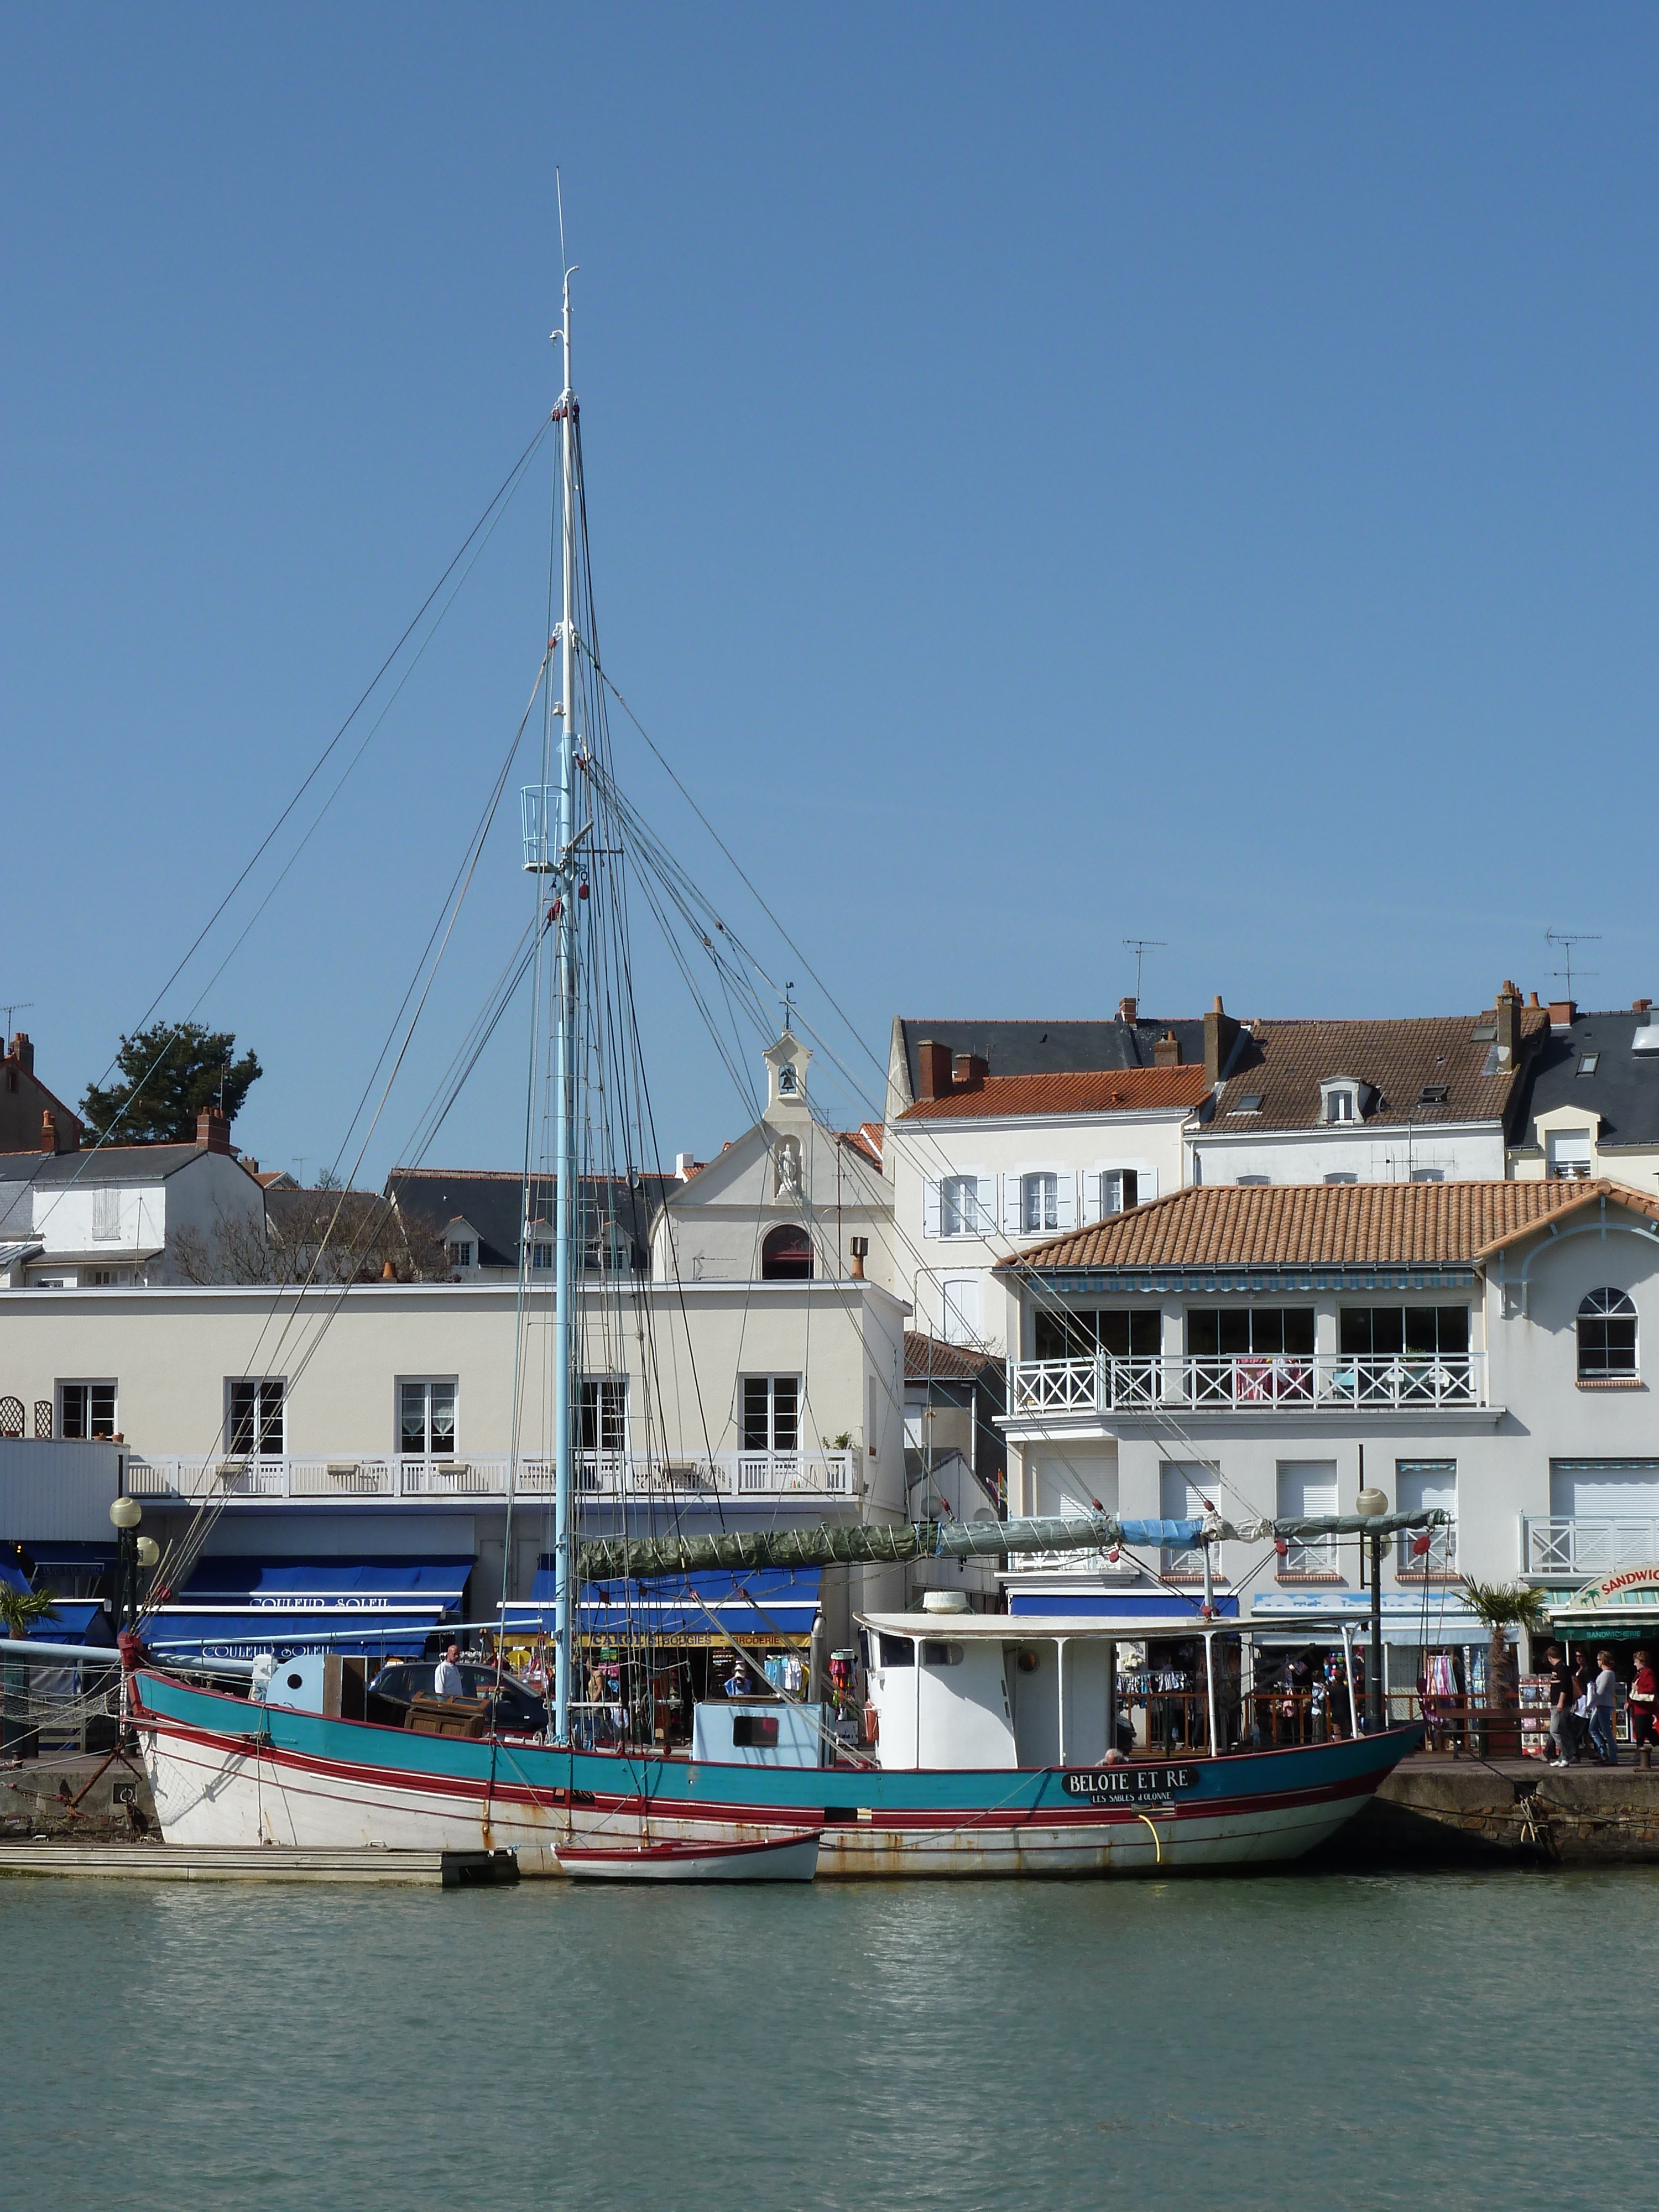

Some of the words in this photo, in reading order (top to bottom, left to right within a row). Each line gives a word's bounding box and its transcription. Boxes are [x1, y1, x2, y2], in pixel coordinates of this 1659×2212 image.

[1586, 1630, 1641, 1639] SANDWICHERIE
[663, 1635, 712, 1645] BOUGIES
[1070, 1773, 1129, 1792] BELOTE
[1138, 1771, 1159, 1788] ET
[1092, 1794, 1107, 1803] LES
[1109, 1793, 1135, 1802] SABLES
